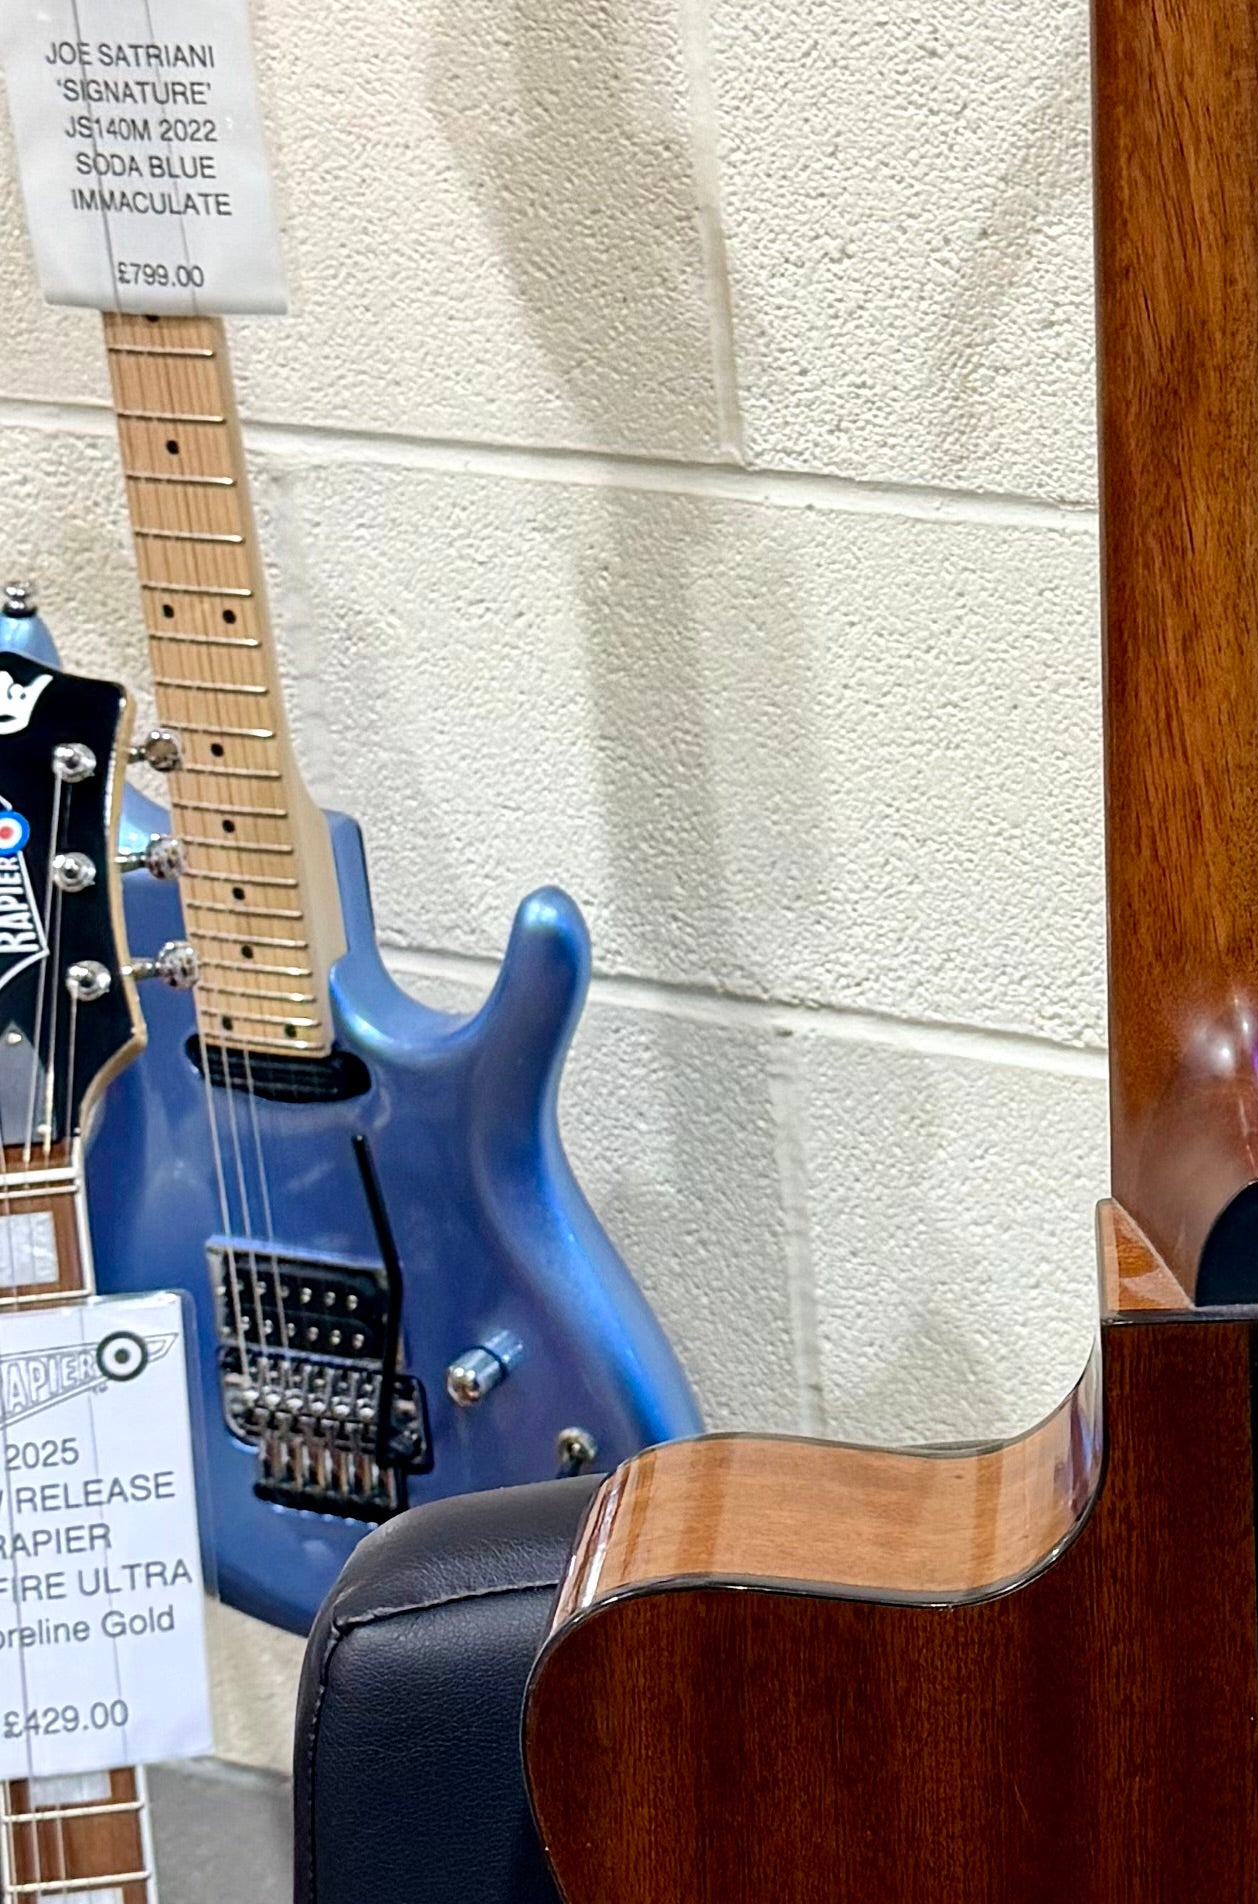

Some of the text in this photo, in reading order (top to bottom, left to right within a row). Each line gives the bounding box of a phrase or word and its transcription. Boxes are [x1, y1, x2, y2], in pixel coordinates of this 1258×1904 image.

[45, 41, 215, 69] JOE SATRIANI
[65, 115, 218, 142] JS140M 2022
[76, 151, 216, 180] SODA BLUE
[71, 188, 232, 217] IMMACULATE
[117, 260, 204, 288] £799.00
[0, 856, 40, 953] RAPIER
[0, 1351, 97, 1415] APIER
[5, 1436, 80, 1472] 2025
[15, 1470, 176, 1514] RELEASE
[78, 1558, 193, 1596] ULTRA
[101, 1603, 175, 1639] Gold
[3, 1699, 129, 1739] £429.00
